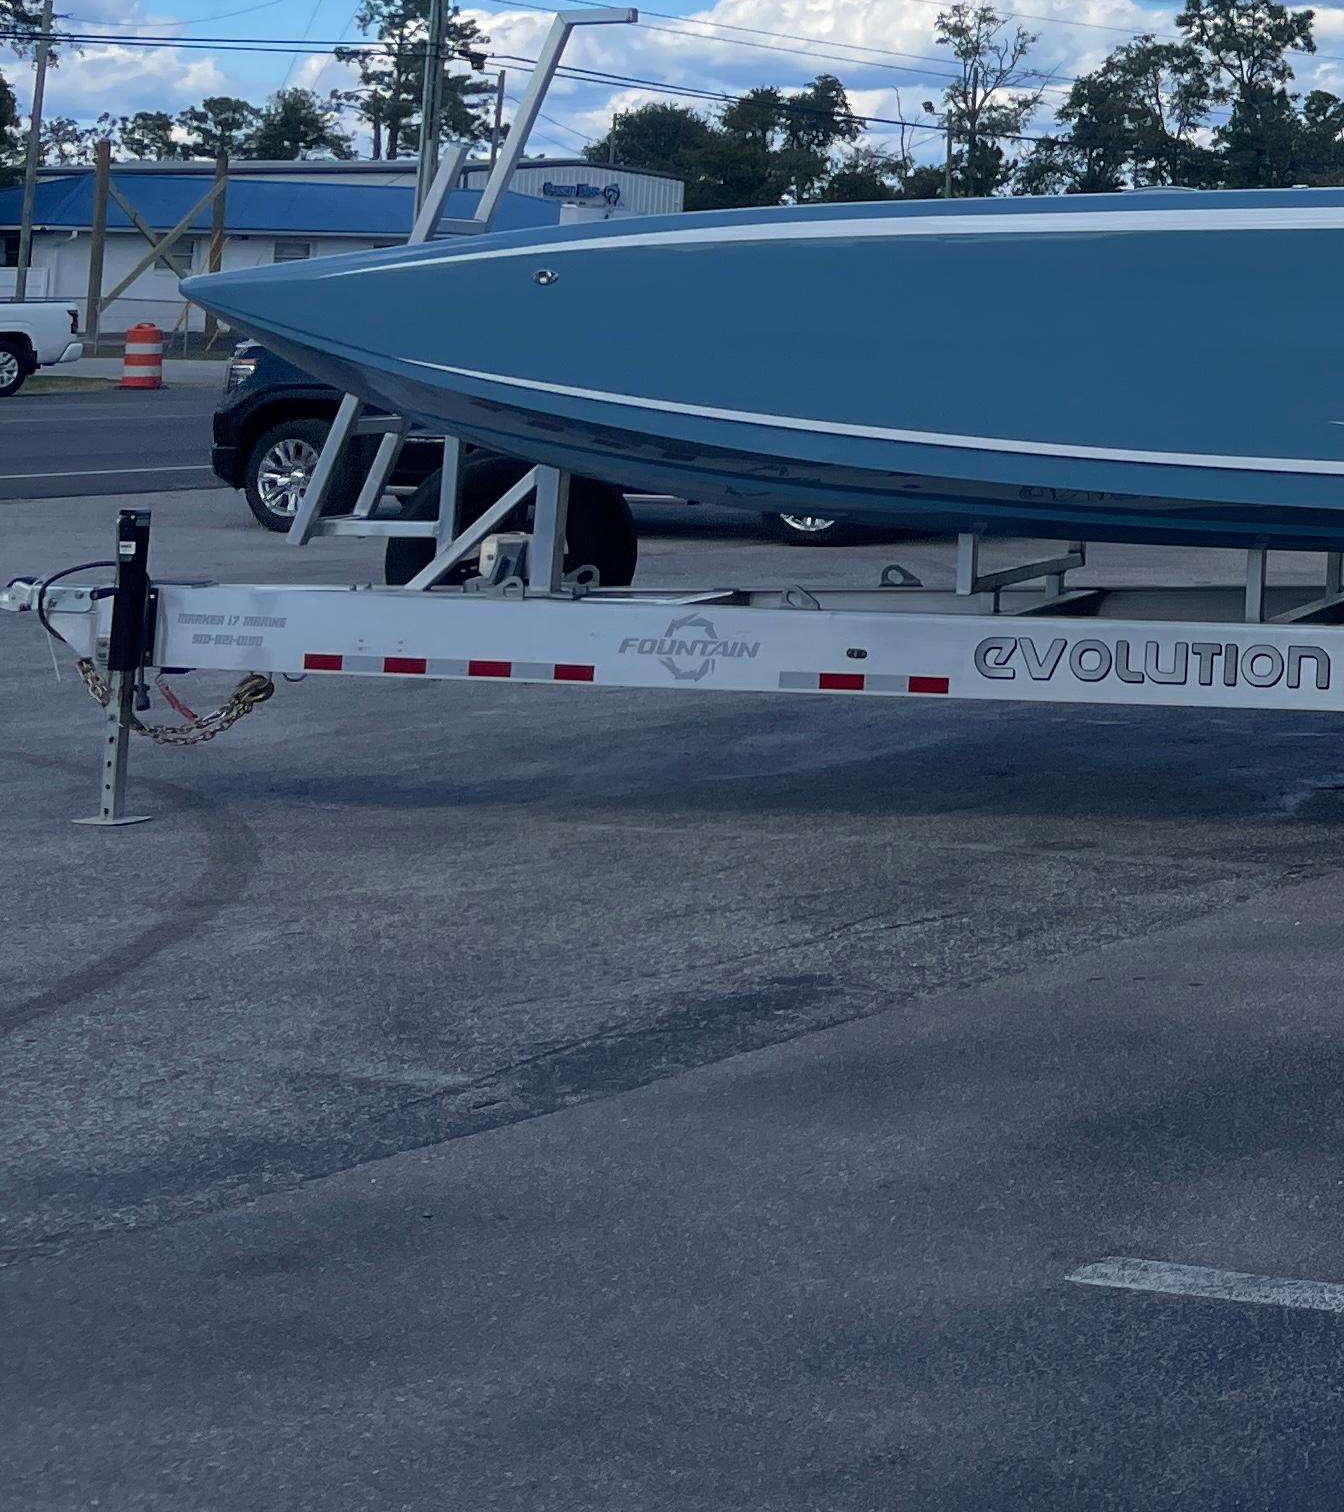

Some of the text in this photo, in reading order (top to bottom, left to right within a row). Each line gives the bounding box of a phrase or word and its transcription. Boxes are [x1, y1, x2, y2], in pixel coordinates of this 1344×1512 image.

[177, 613, 288, 628] MARKER 17 MARINE
[618, 637, 761, 659] FOUNTAIN
